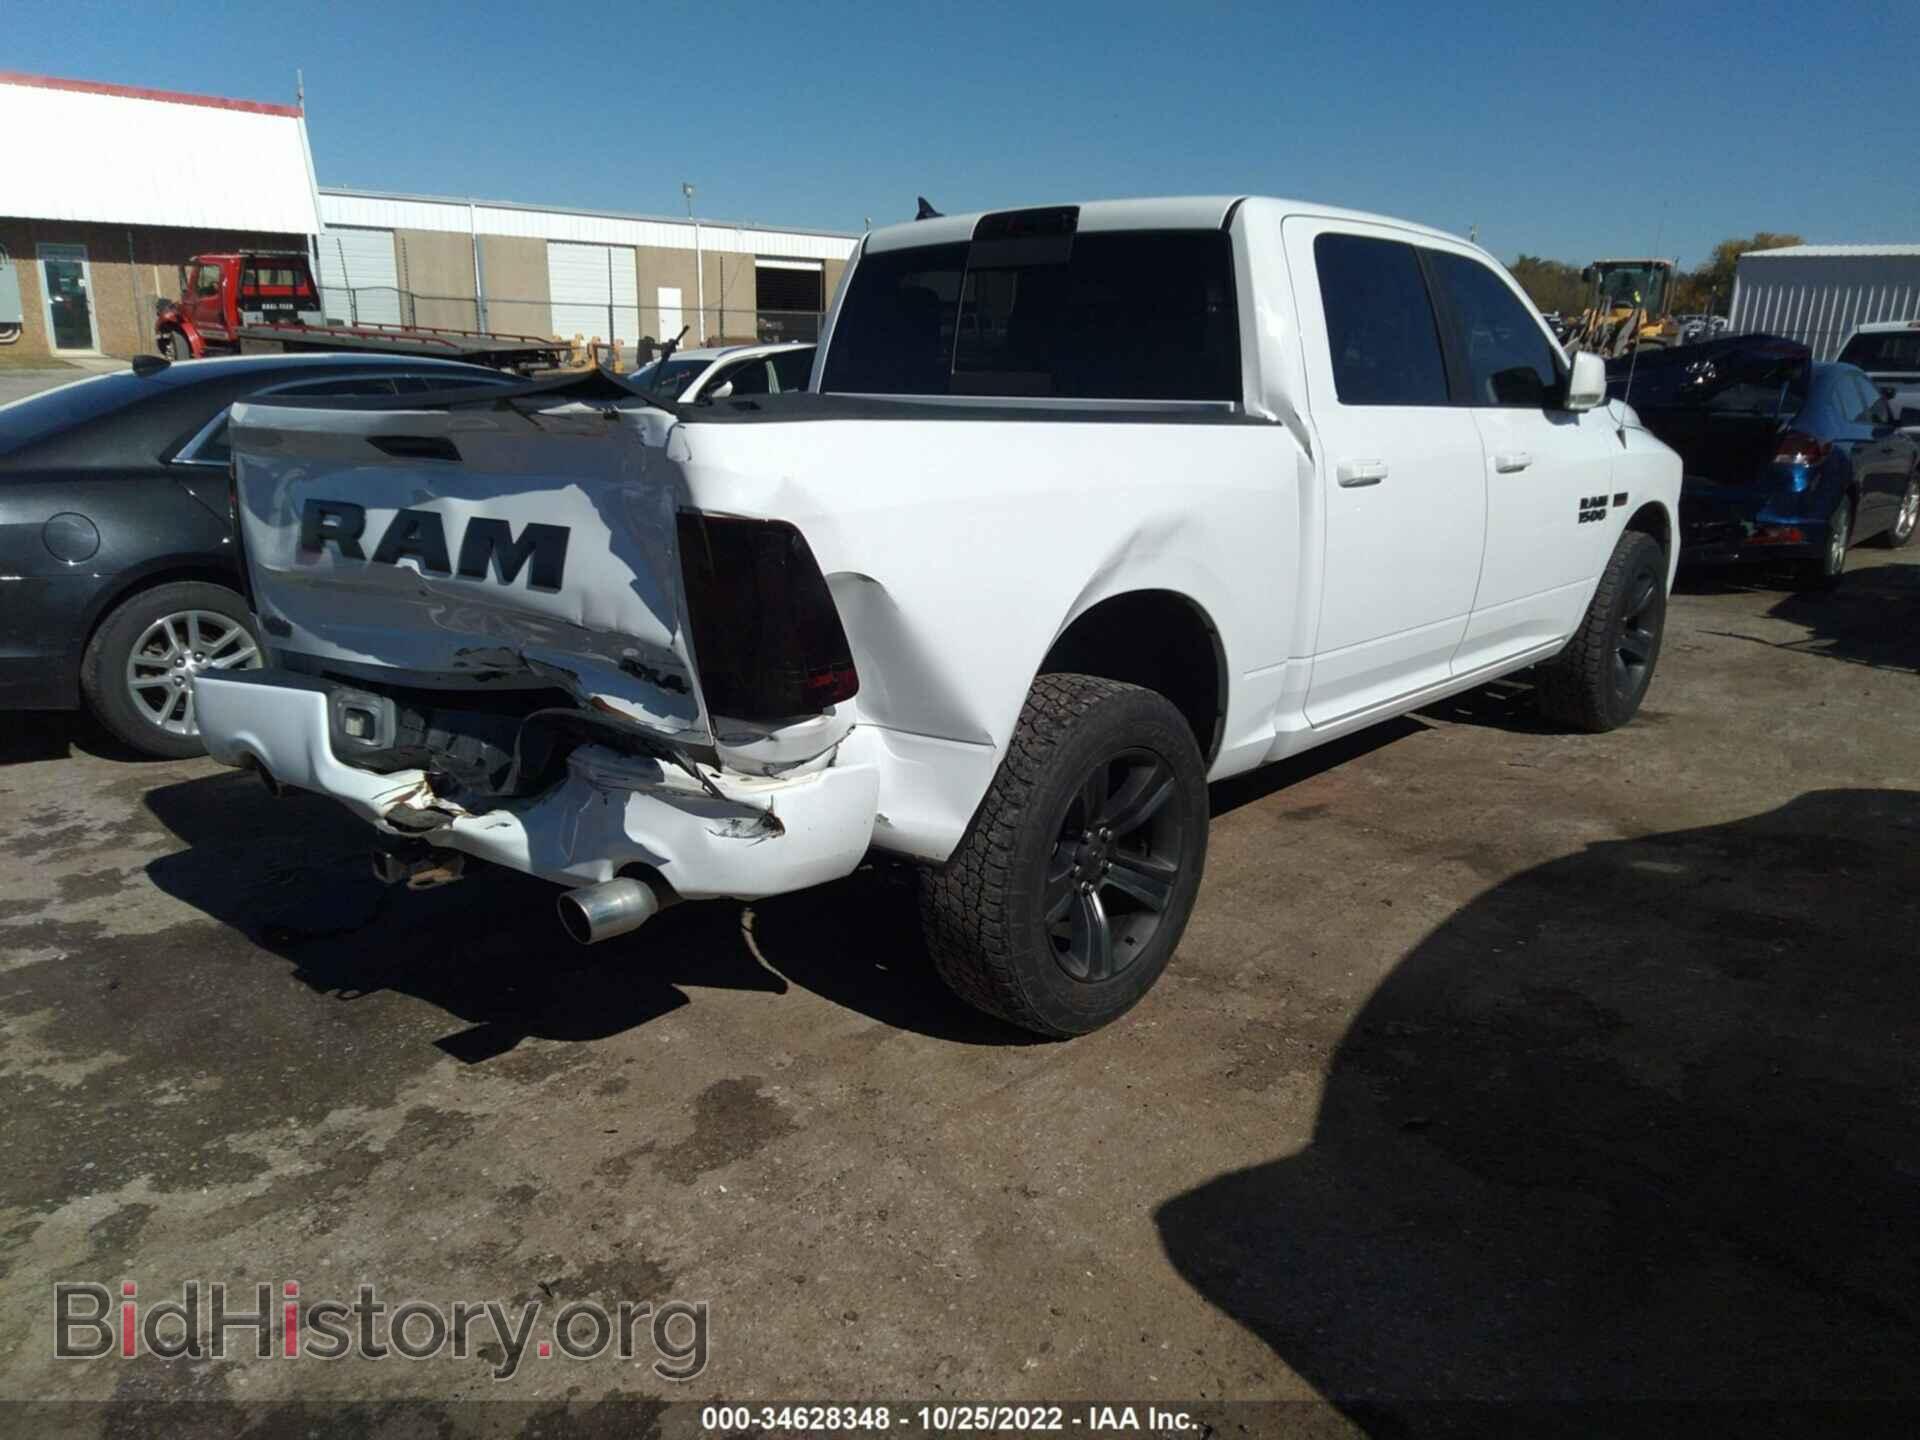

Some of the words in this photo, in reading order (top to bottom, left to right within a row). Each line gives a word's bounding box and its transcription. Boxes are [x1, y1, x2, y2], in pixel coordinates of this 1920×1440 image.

[1580, 495, 1608, 510] RAM
[1578, 509, 1606, 524] 1500
[295, 499, 571, 594] RAM
